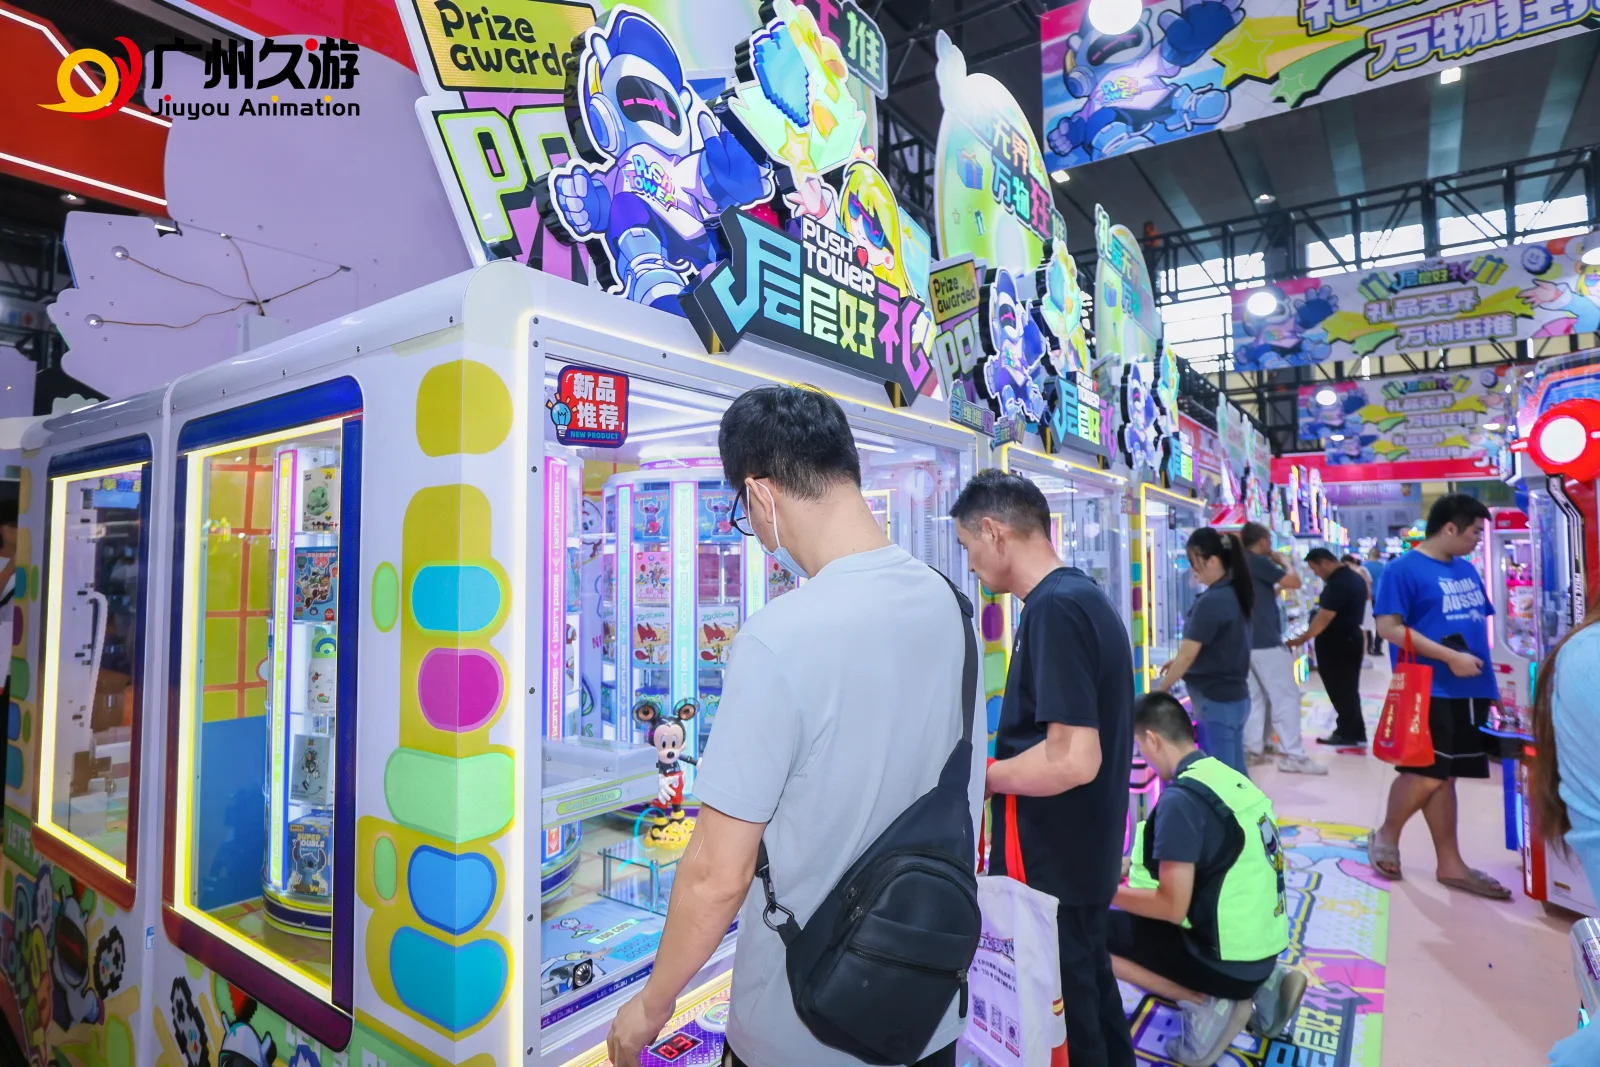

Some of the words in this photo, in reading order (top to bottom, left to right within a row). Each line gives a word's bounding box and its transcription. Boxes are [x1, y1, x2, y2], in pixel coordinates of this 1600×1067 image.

[437, 1, 537, 43] Prize
[1371, 0, 1600, 77] 万物狂
[803, 217, 854, 263] PUSH
[710, 213, 931, 392] 层层好礼
[933, 277, 959, 298] Prize
[937, 283, 977, 313] awarded
[1366, 289, 1478, 323] 礼品无界
[1399, 313, 1514, 346] 万物狂推
[573, 373, 616, 403] 新品
[577, 401, 619, 430] 推荐
[587, 432, 619, 440] PRODUCT
